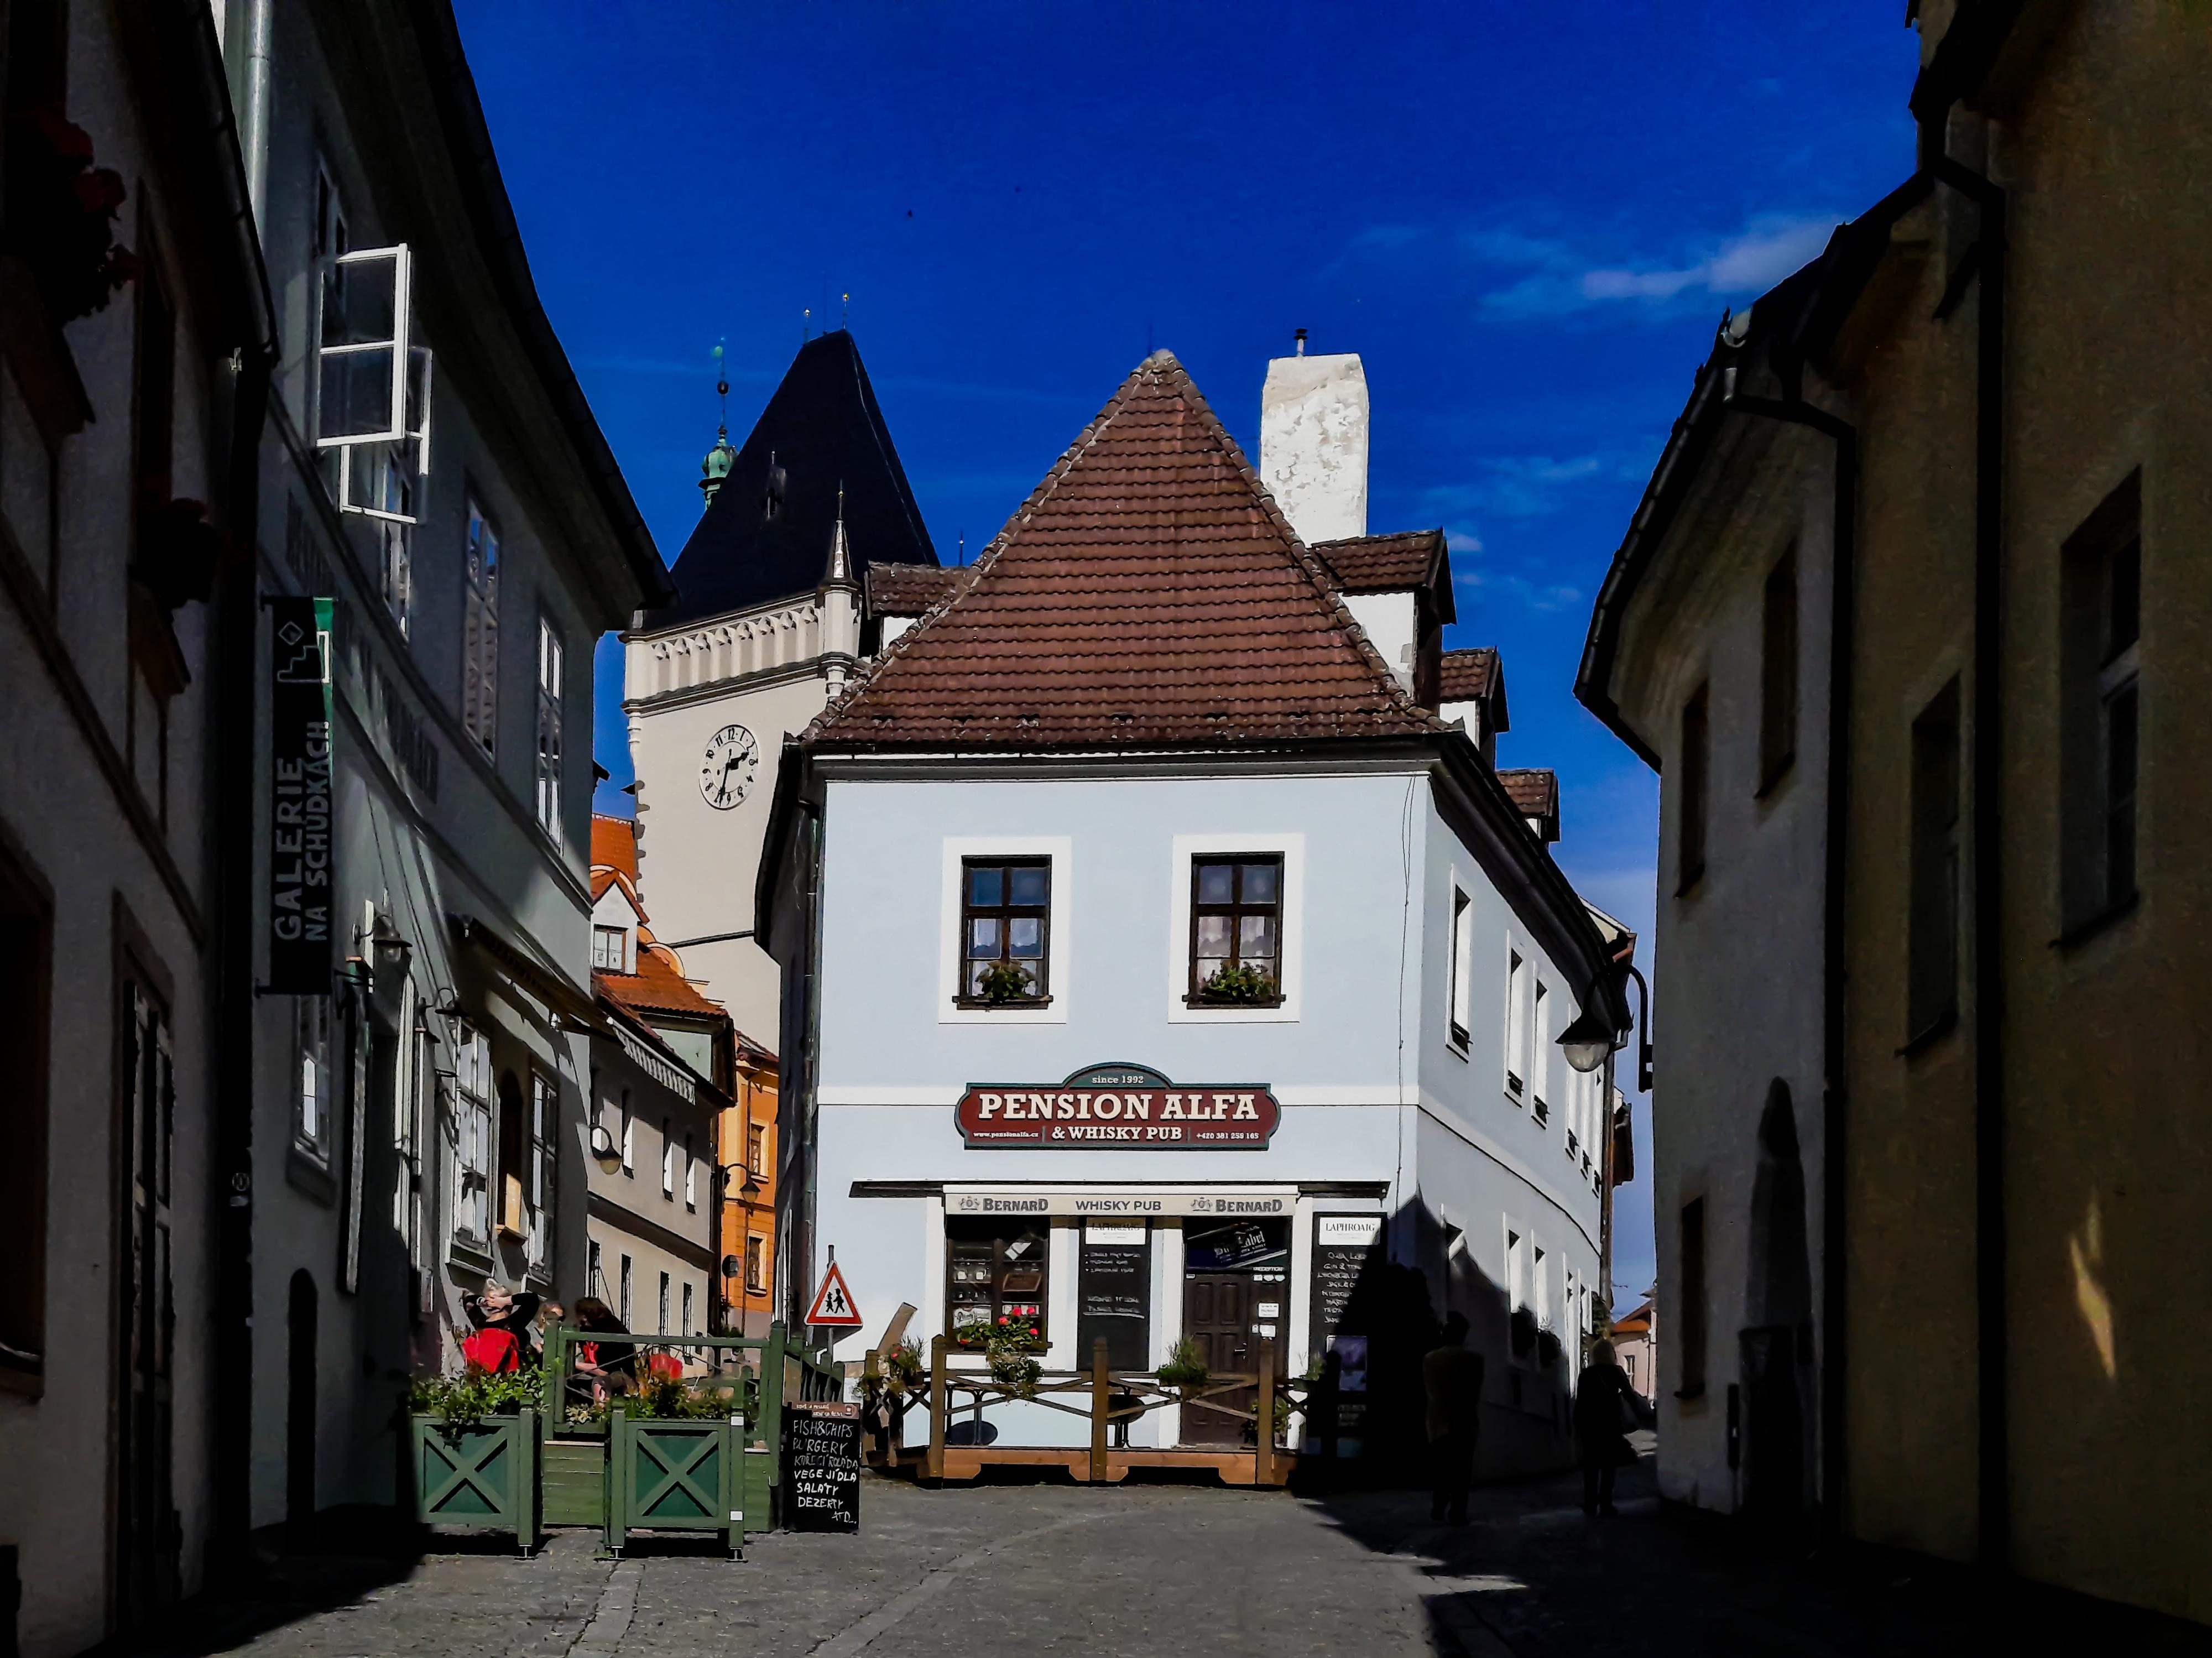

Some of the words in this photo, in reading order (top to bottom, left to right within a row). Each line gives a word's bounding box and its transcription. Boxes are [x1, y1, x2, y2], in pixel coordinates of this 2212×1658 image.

[273, 756, 303, 941] GALERIE
[304, 906, 328, 942] NA
[1092, 1075, 1119, 1084] since
[1121, 1075, 1144, 1084] 1992
[978, 1093, 1154, 1121] PENSION
[1160, 1093, 1259, 1121] ALFA
[1051, 1126, 1066, 1140] &
[1067, 1126, 1142, 1141] WHISKY
[1145, 1126, 1182, 1141] PUB
[983, 1198, 1048, 1211] BERNARD
[1075, 1201, 1131, 1211] WHISKY
[1134, 1201, 1162, 1211] PUB
[1215, 1199, 1283, 1212] BERNARD
[1326, 1223, 1375, 1231] LAPHROAIG
[794, 1469, 824, 1479] VEGE
[826, 1468, 857, 1483] JÍDLA
[796, 1482, 839, 1496] SALÁTY
[798, 1496, 844, 1509] DEZERTY
